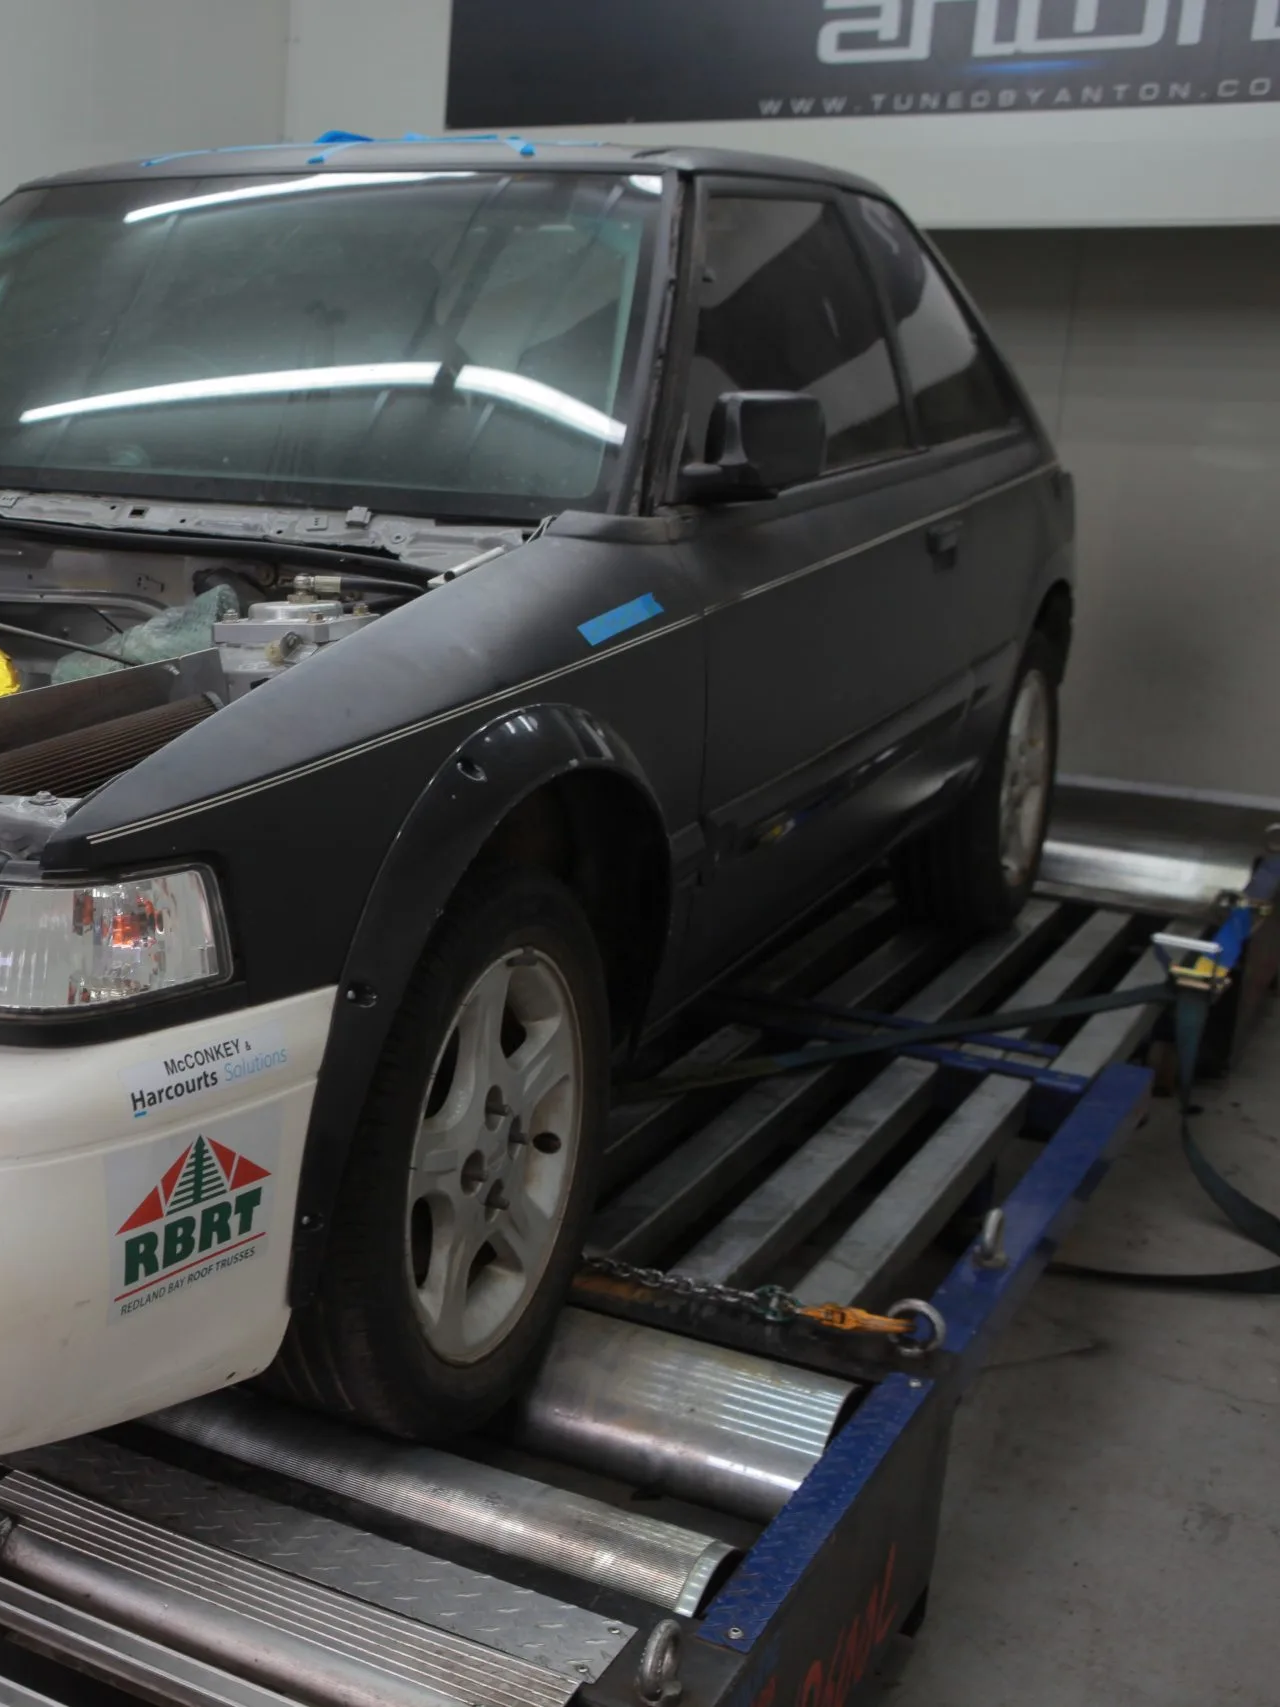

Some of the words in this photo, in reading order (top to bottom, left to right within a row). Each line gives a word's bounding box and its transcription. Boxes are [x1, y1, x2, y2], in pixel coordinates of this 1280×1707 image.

[131, 1071, 218, 1112] Harcourts
[224, 1048, 287, 1081] Solutions
[163, 1039, 241, 1076] McCONKEY
[123, 1186, 262, 1286] RBRT
[120, 1286, 165, 1315] REDLAND
[167, 1276, 186, 1294] BAY
[187, 1264, 214, 1284] ROOF
[215, 1246, 256, 1271] TRUSSES
